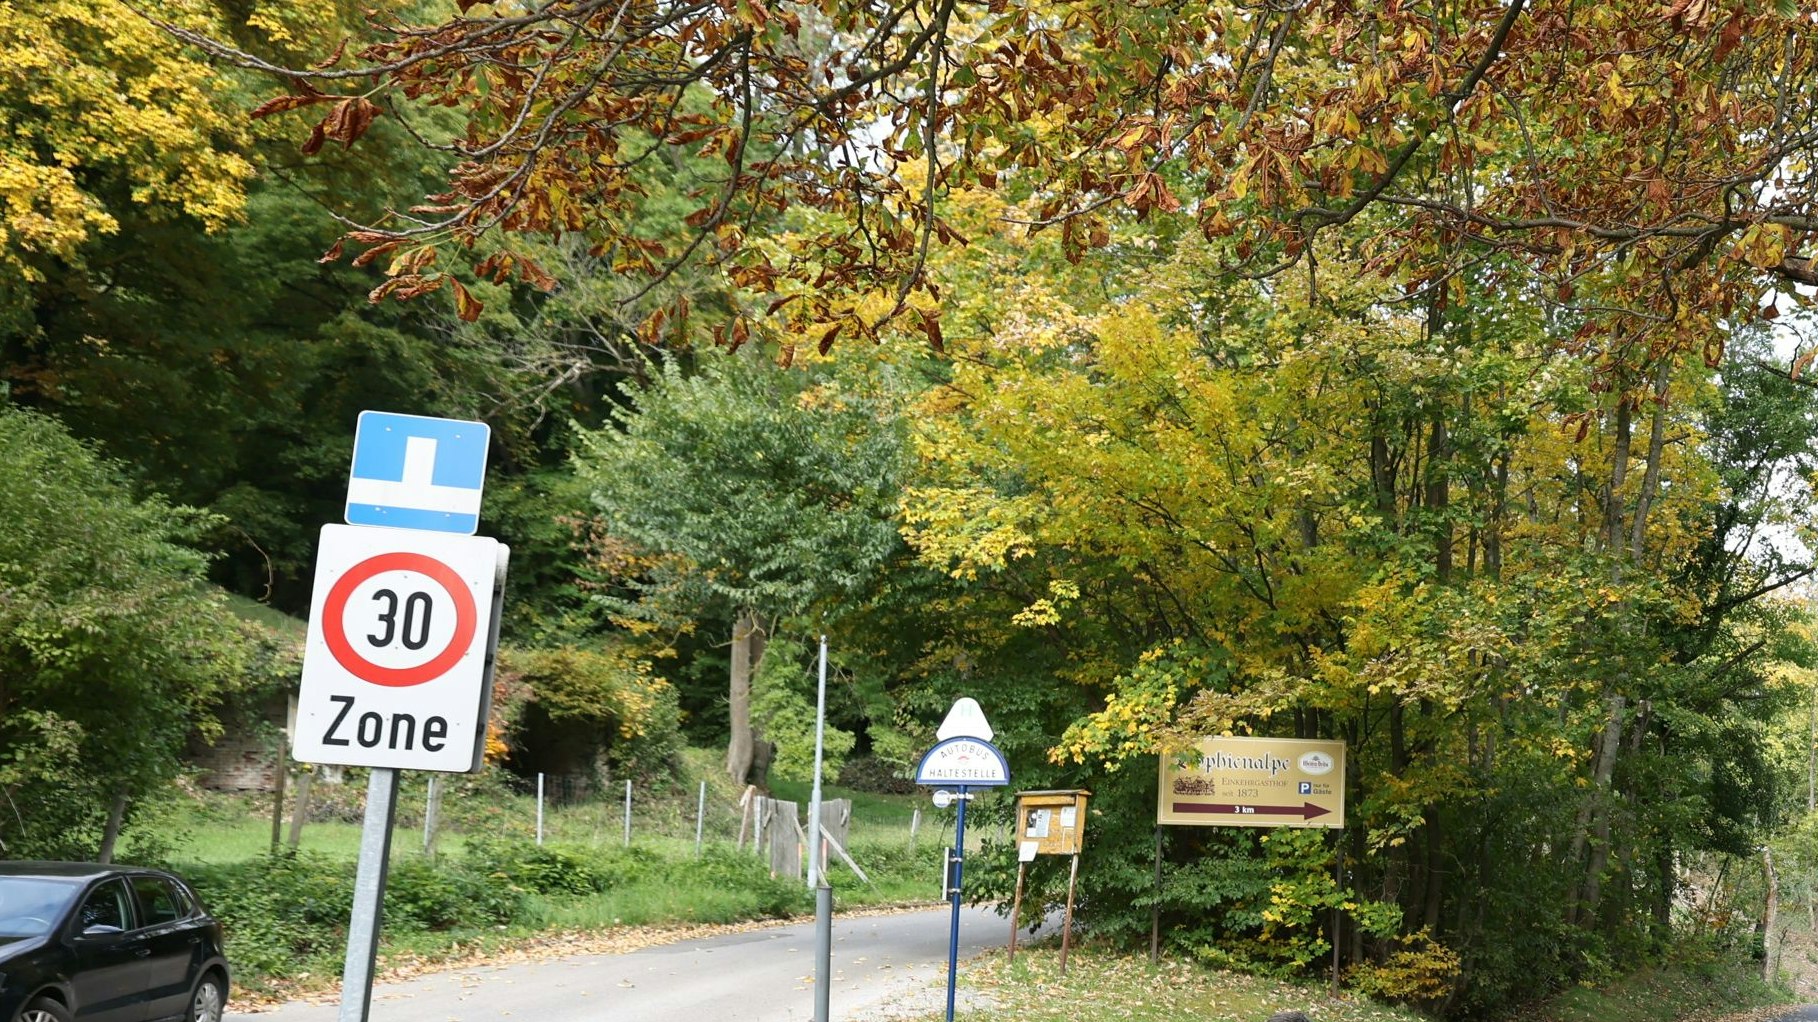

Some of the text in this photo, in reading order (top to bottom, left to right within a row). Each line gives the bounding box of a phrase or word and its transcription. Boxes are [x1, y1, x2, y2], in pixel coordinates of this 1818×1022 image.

[366, 588, 433, 651] 30
[322, 694, 448, 753] Zone
[940, 744, 990, 761] AUTOBUS
[1177, 751, 1290, 775] phienalpe
[929, 769, 997, 778] HALTESTELLE
[1237, 788, 1259, 798] 1873
[1234, 805, 1255, 814] 3 km
